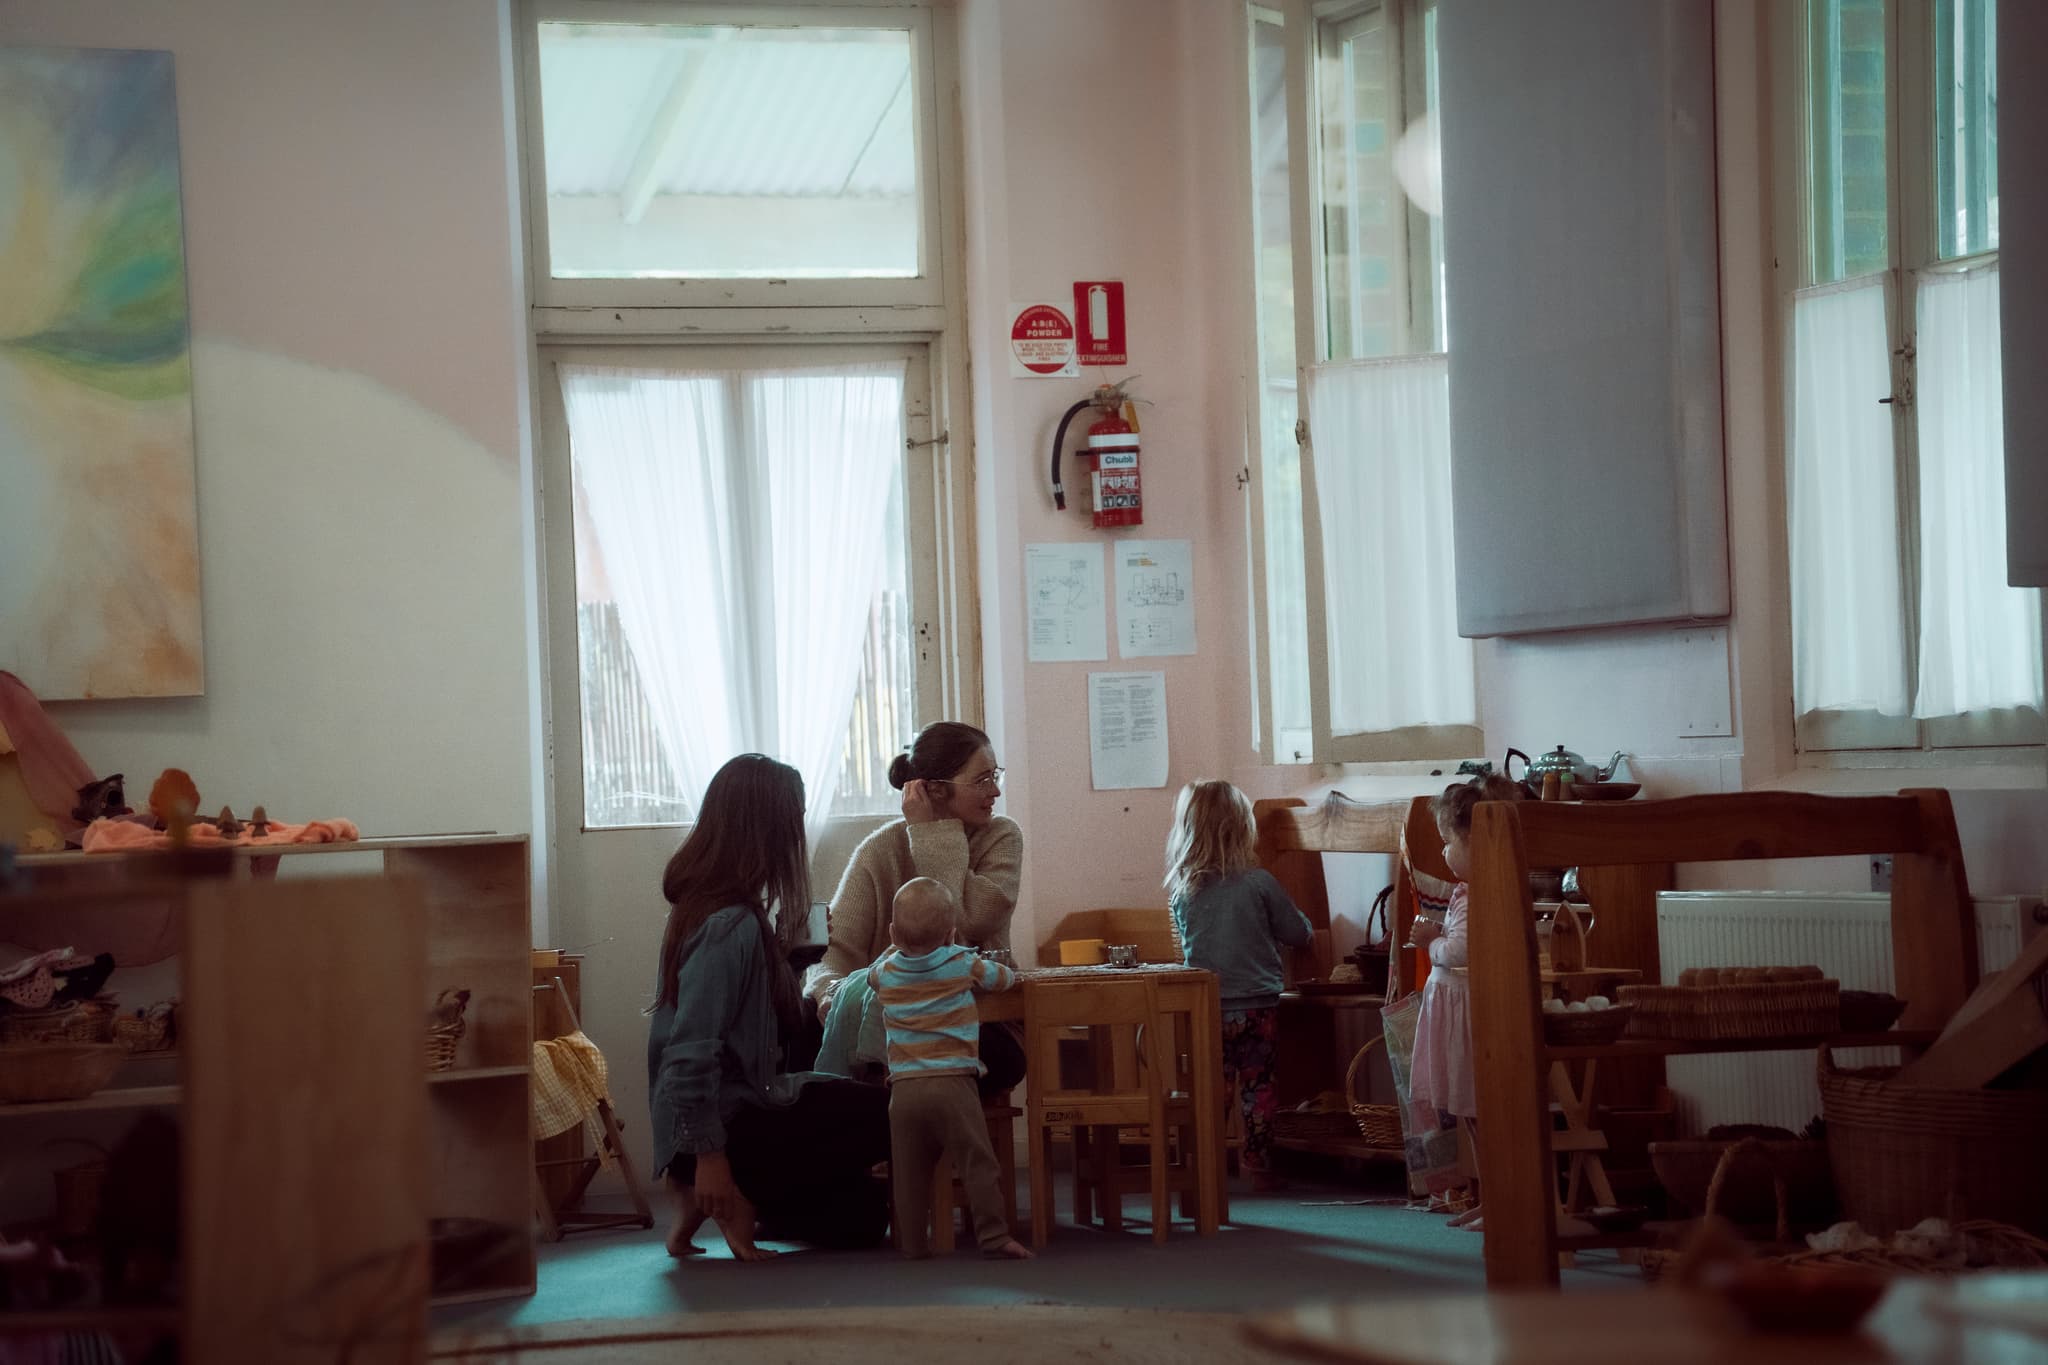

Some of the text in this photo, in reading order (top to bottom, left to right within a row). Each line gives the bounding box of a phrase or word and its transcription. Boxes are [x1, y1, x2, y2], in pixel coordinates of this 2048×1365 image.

[1026, 329, 1062, 337] POWDER
[1092, 343, 1108, 351] FIRE
[1105, 455, 1134, 464] Chubb
